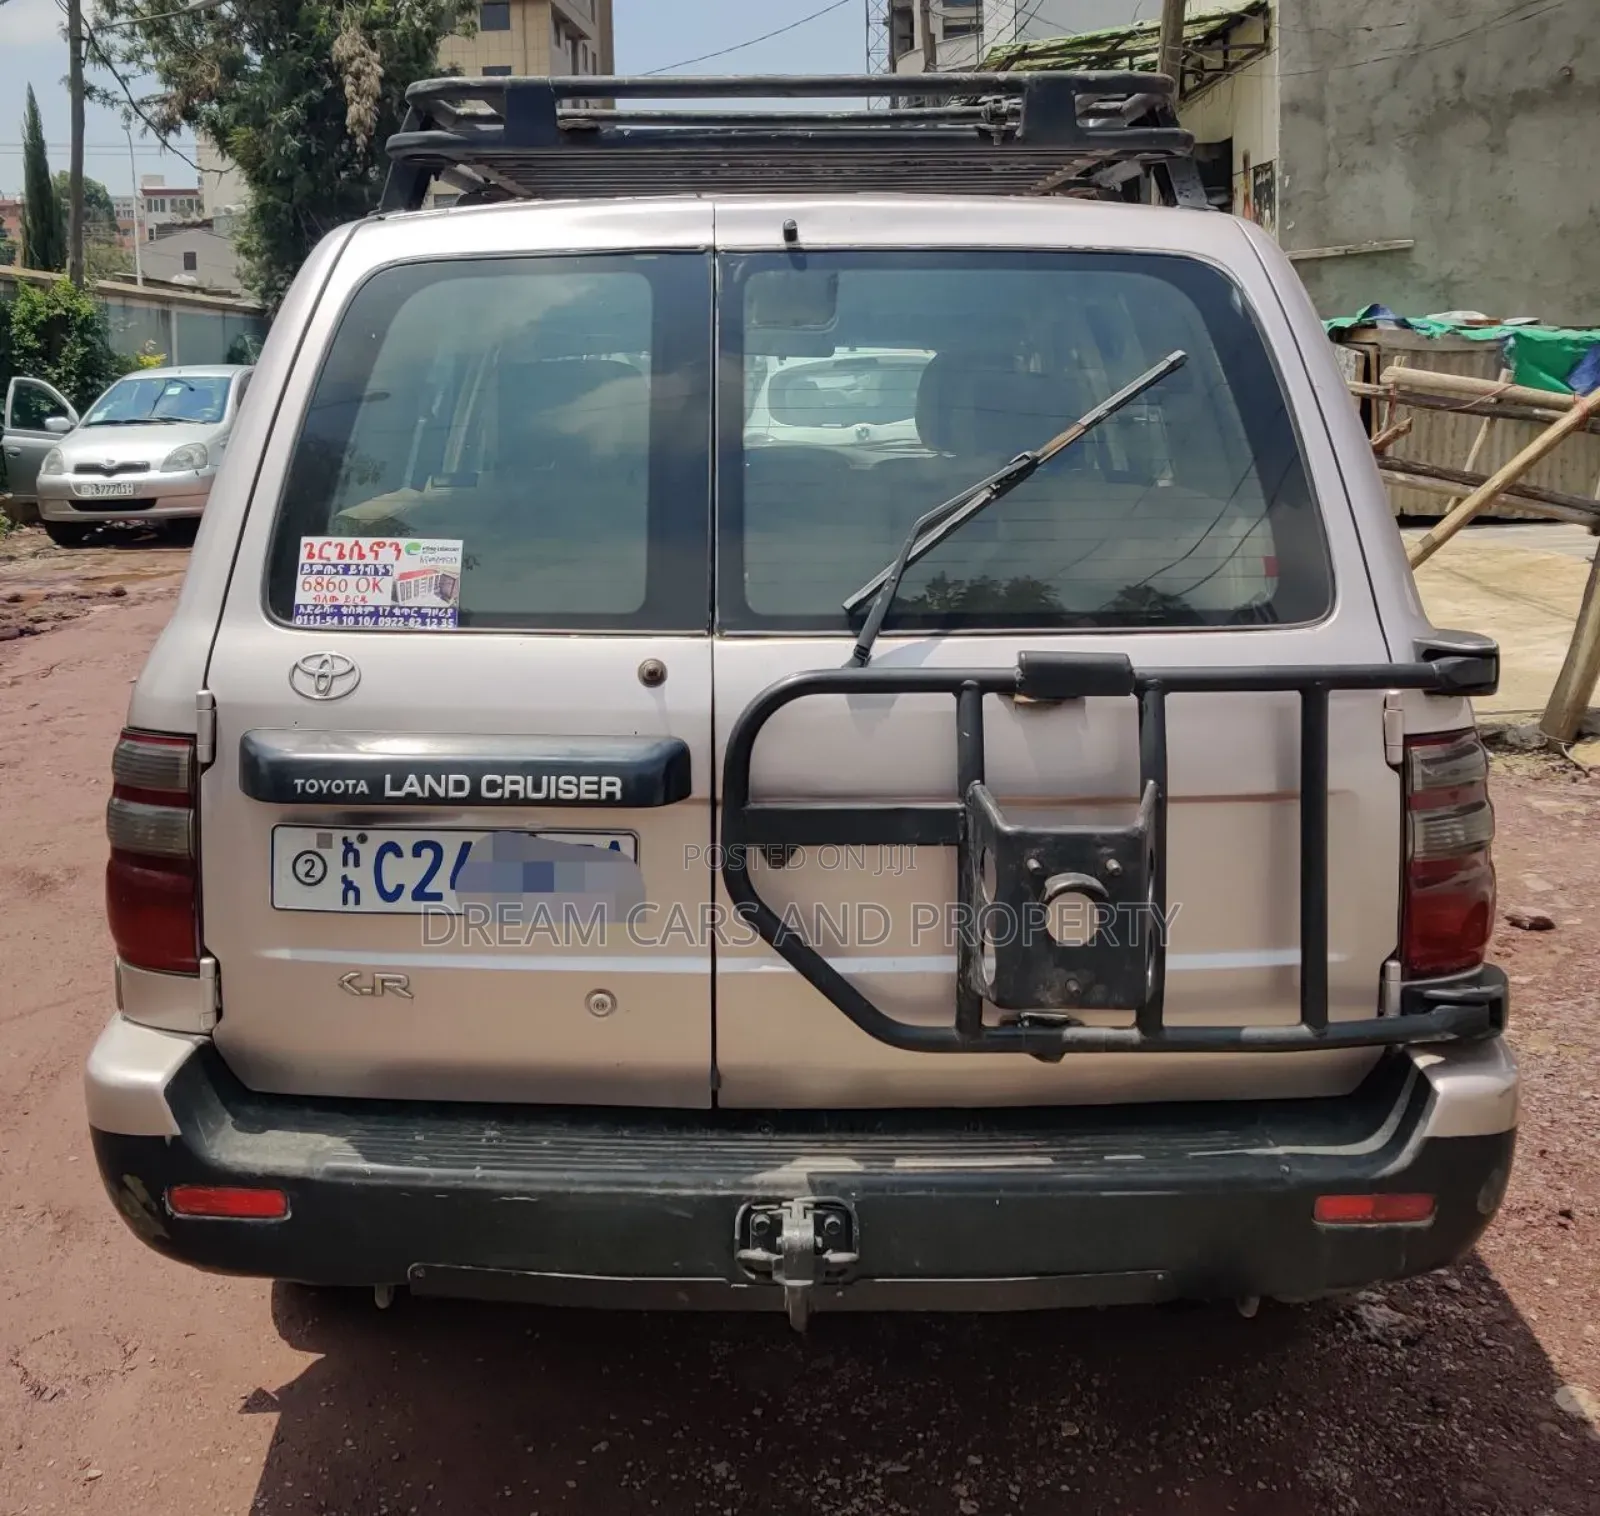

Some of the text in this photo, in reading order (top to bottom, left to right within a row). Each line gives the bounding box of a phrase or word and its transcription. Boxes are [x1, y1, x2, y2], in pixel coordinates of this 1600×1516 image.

[301, 576, 385, 594] 6860 OK
[378, 606, 391, 616] 17
[295, 614, 339, 625] 0111-54
[342, 615, 355, 626] 10
[293, 773, 623, 801] TOYOTA LAND CRUISER
